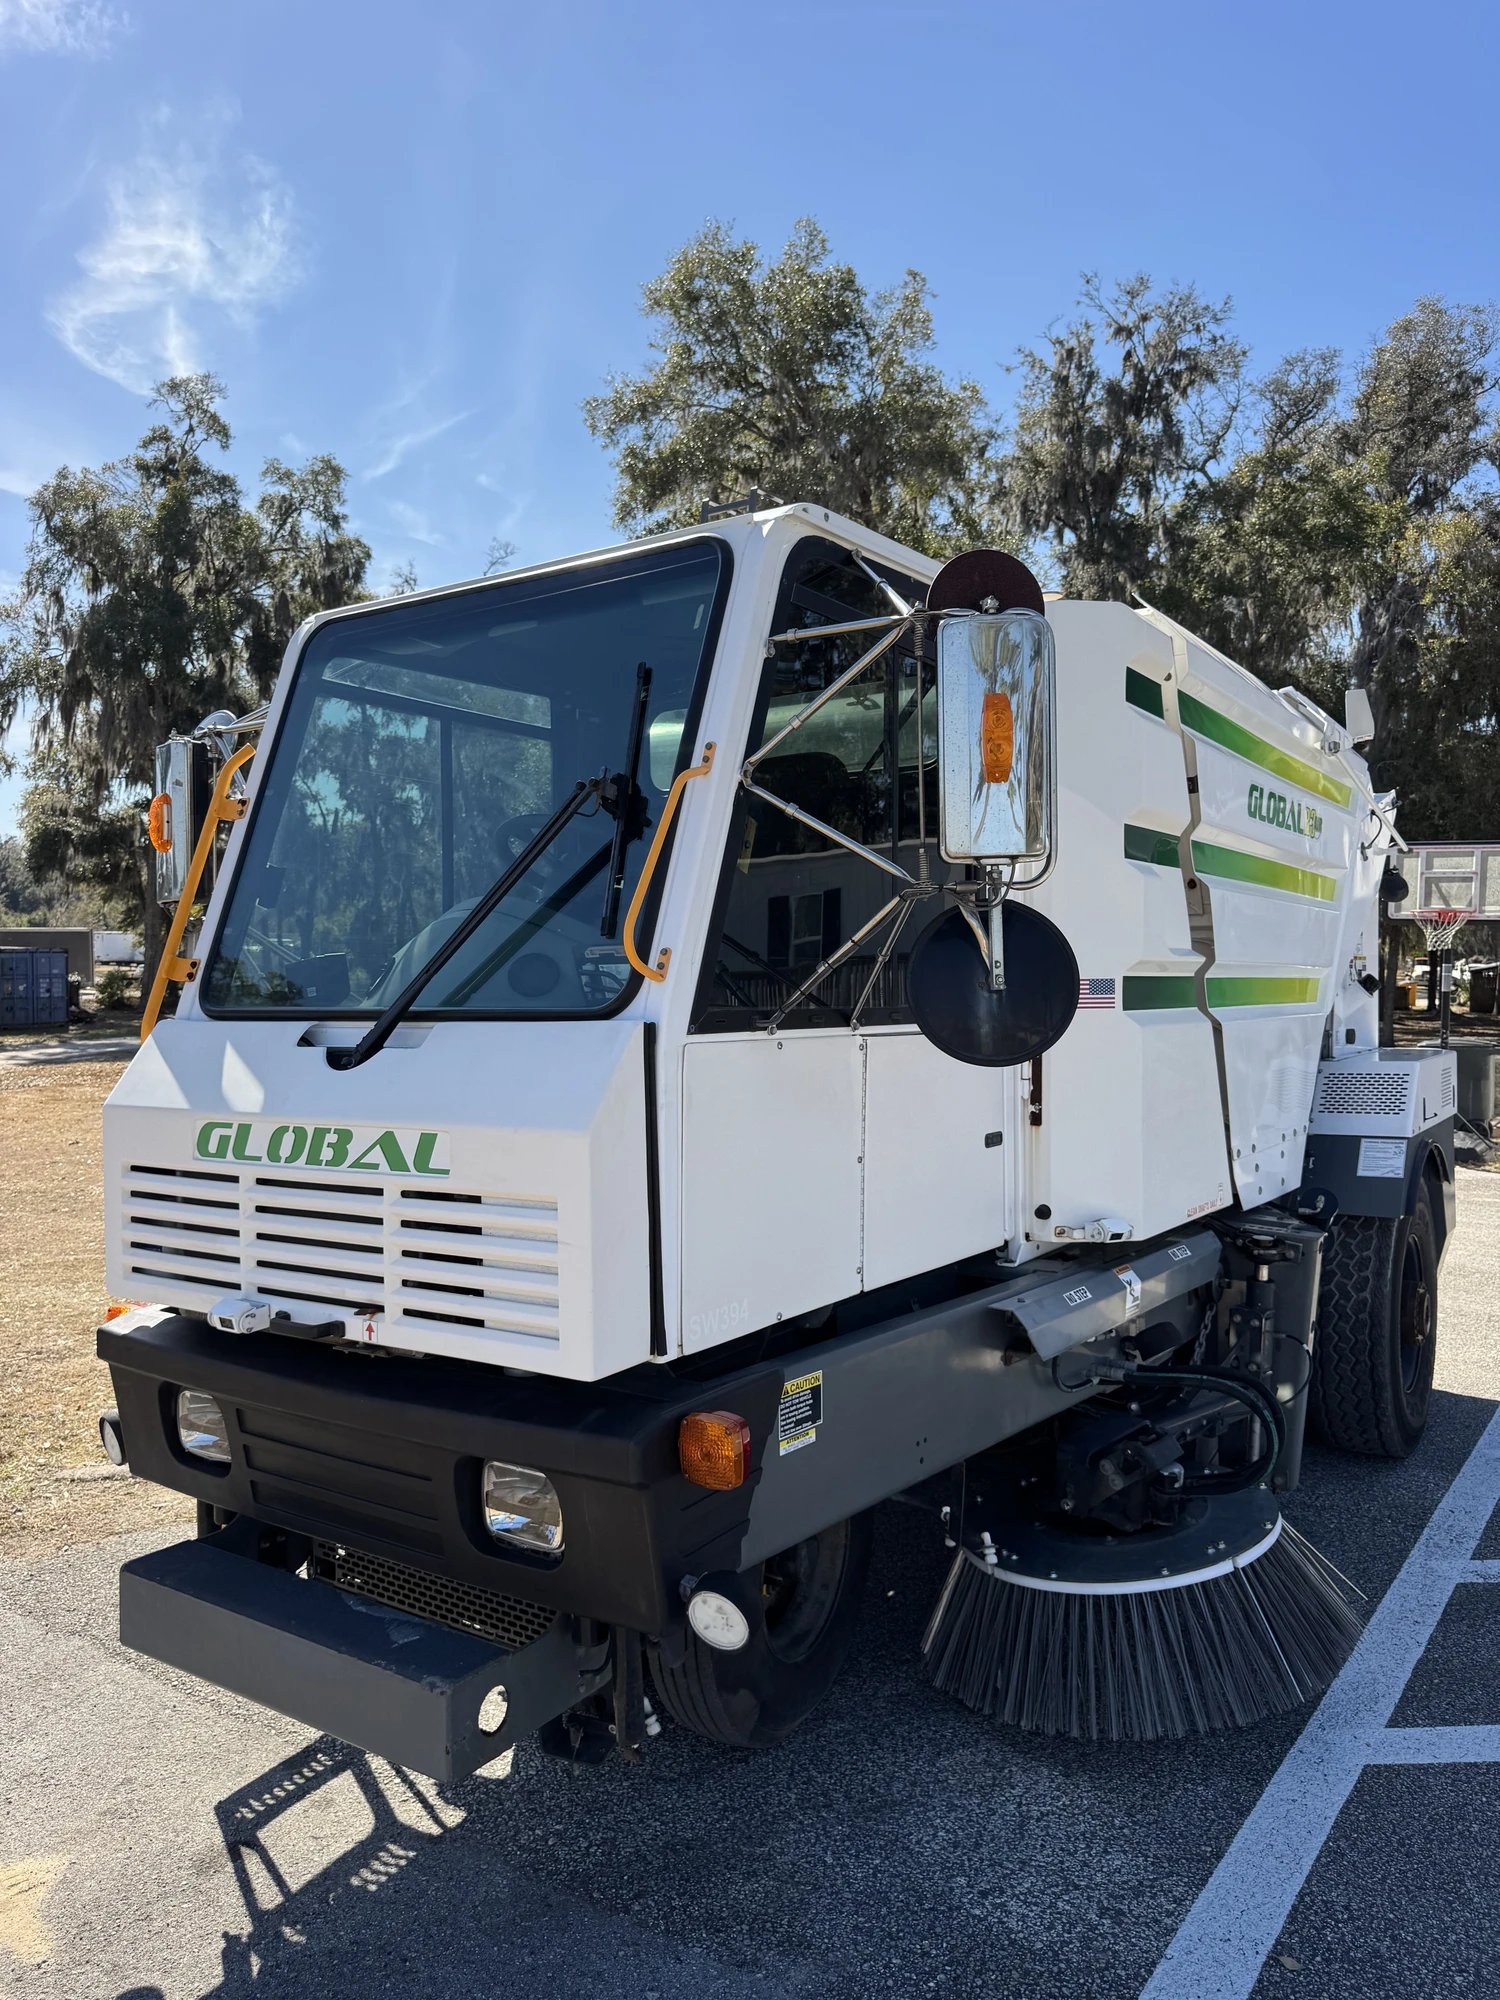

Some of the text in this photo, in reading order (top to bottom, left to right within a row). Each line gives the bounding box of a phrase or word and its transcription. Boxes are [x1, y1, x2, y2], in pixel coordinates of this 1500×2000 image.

[1248, 784, 1304, 835] GLOBAL
[196, 1122, 450, 1175] GLOBAL
[1176, 1246, 1188, 1256] STEP
[1065, 1287, 1088, 1304] NO STEP
[690, 1297, 749, 1340] SW394
[790, 1374, 820, 1393] CAUTION
[786, 1431, 809, 1444] ATTENTION
